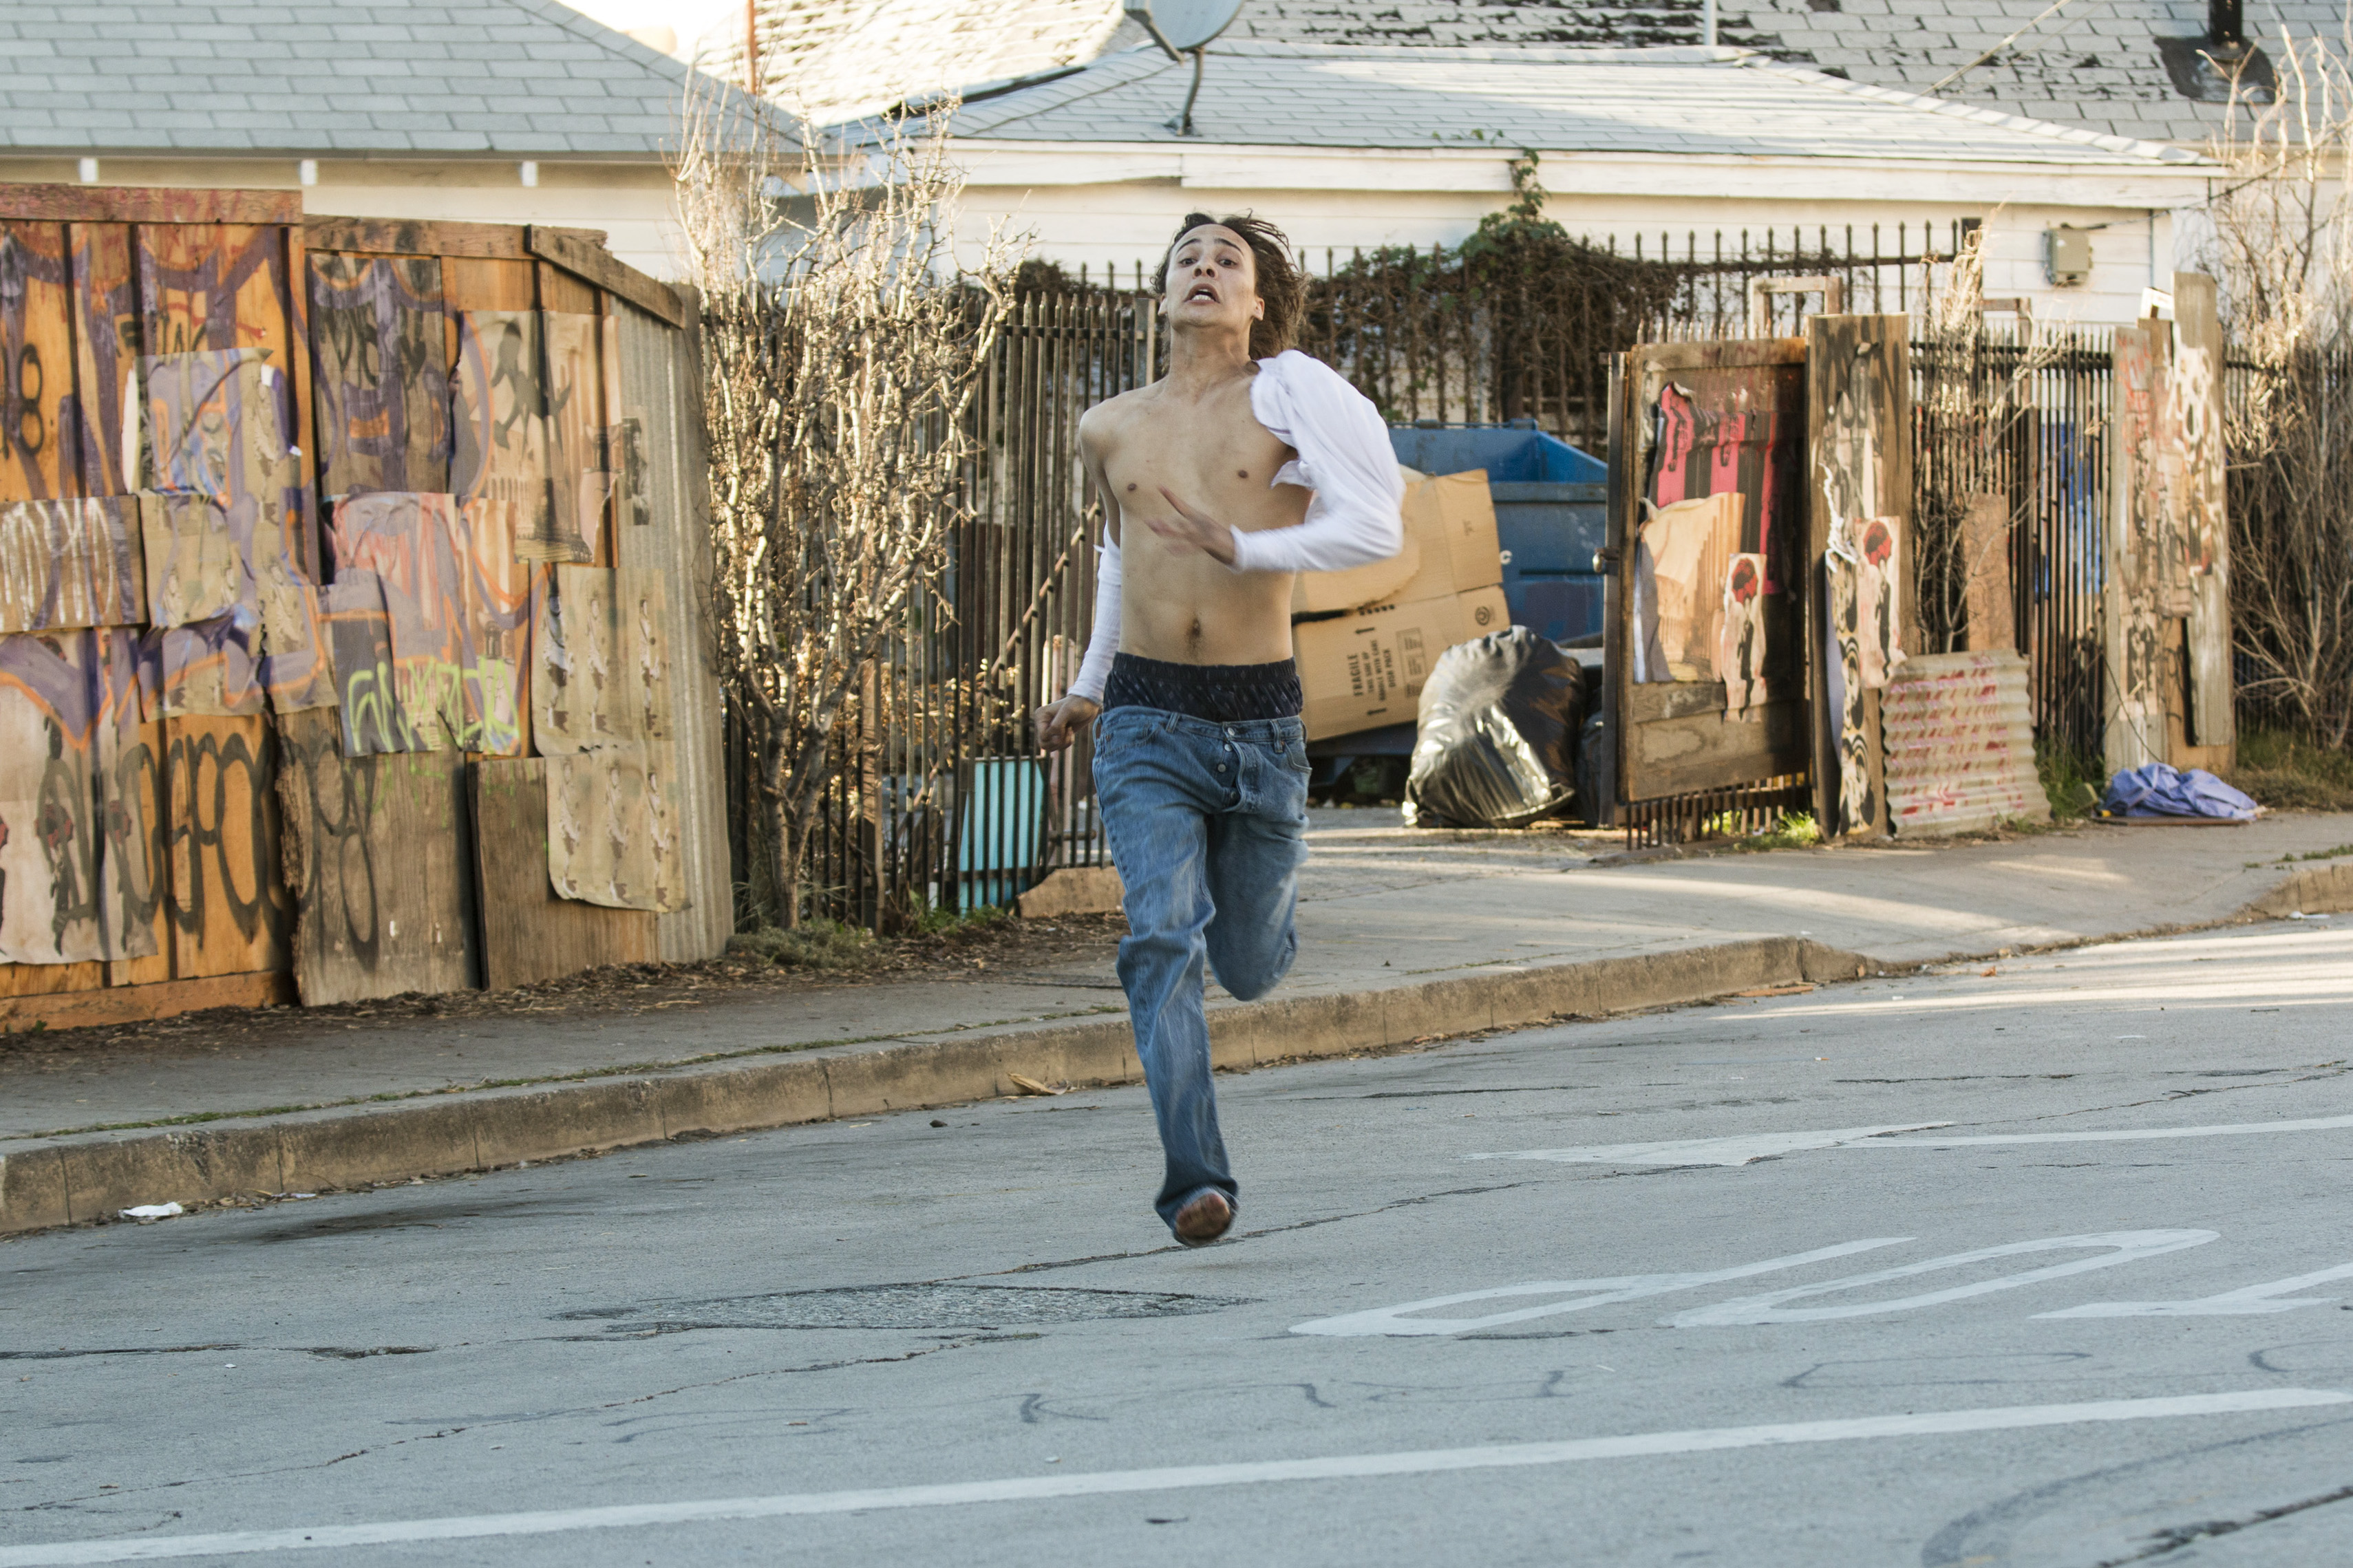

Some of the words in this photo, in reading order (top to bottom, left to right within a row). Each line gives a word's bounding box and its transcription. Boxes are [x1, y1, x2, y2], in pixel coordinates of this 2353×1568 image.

[1374, 658, 1383, 674] WITH
[1383, 649, 1393, 668] PACK
[1348, 654, 1363, 696] FRAGILE
[1387, 670, 1396, 687] DISH
